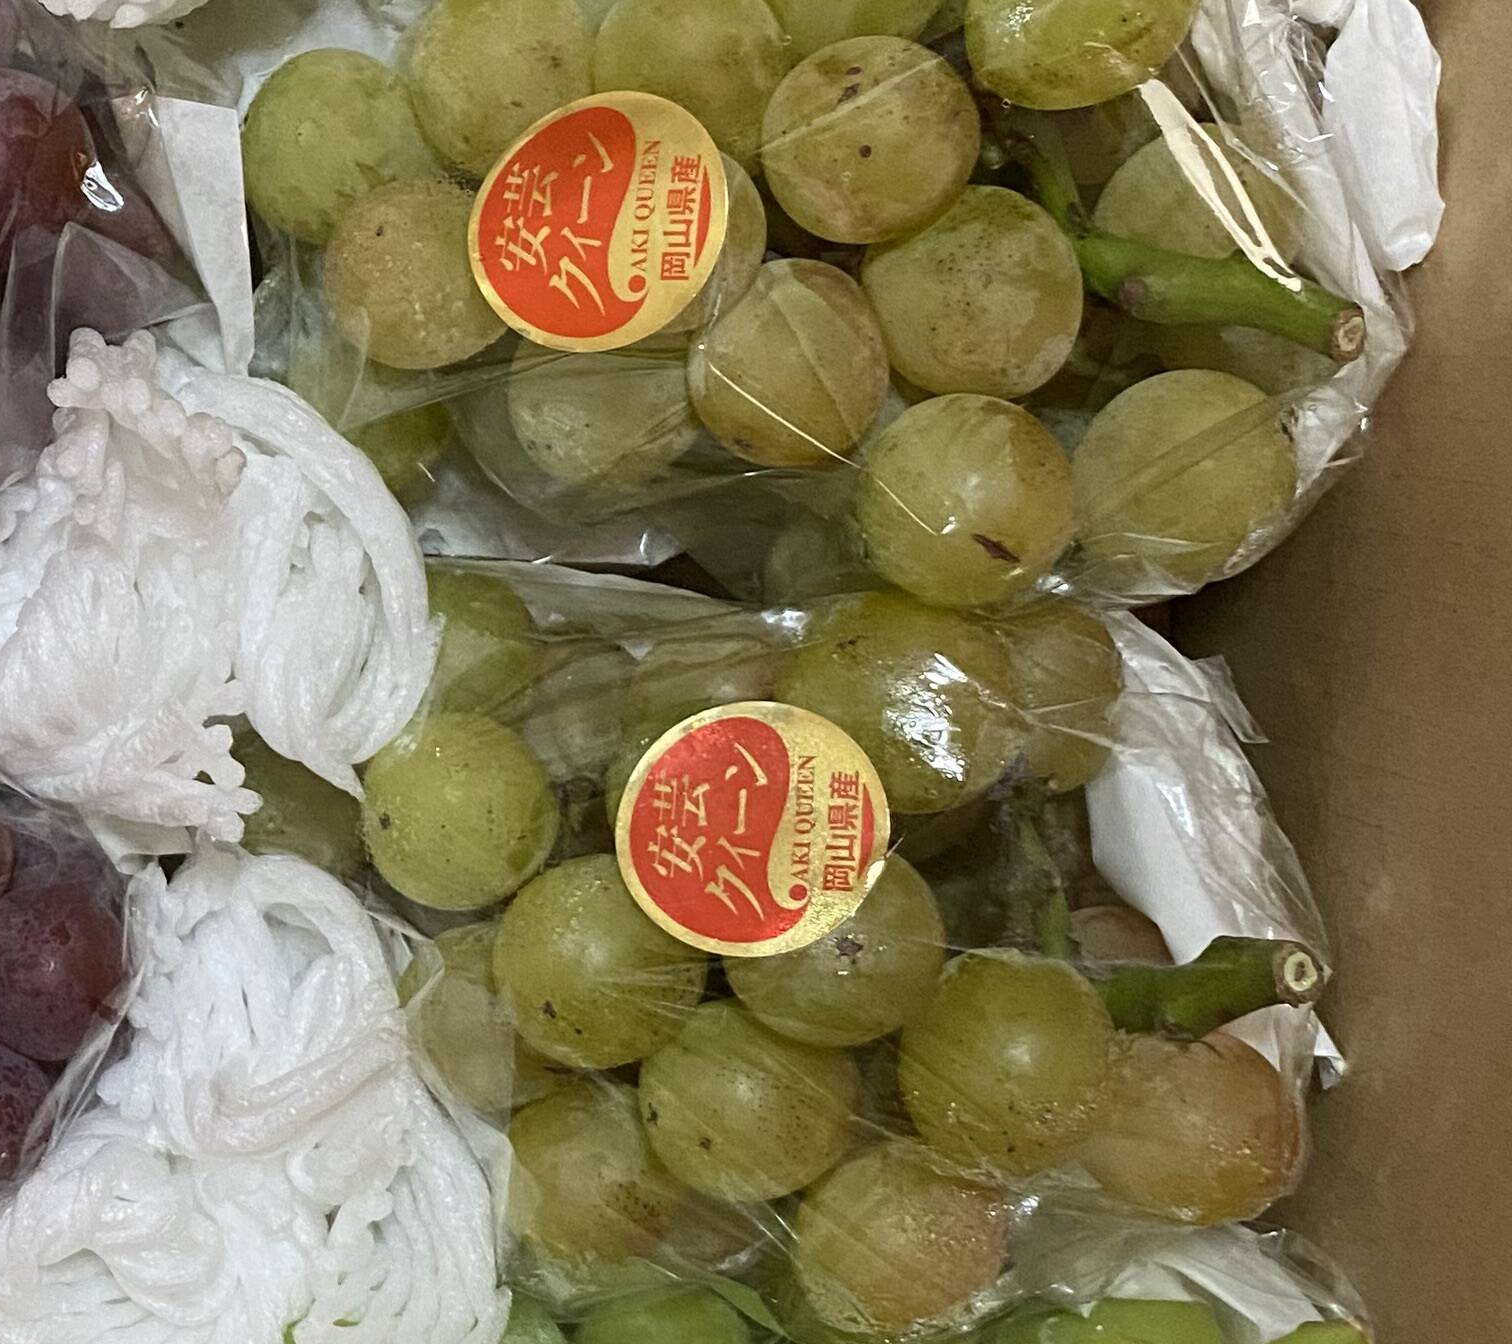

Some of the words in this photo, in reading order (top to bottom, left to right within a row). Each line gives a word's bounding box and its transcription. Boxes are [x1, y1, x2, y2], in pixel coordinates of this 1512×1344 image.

[495, 162, 560, 274] 安芸
[549, 131, 615, 315] クィーン
[634, 139, 662, 221] QUEEN
[659, 154, 701, 281] 岡山県産
[630, 228, 650, 273] AKI
[648, 774, 710, 881] 安芸
[704, 741, 768, 921] クィーン
[795, 754, 817, 834] QUEEN
[821, 770, 860, 892] 岡山県産
[791, 841, 811, 881] AKI
